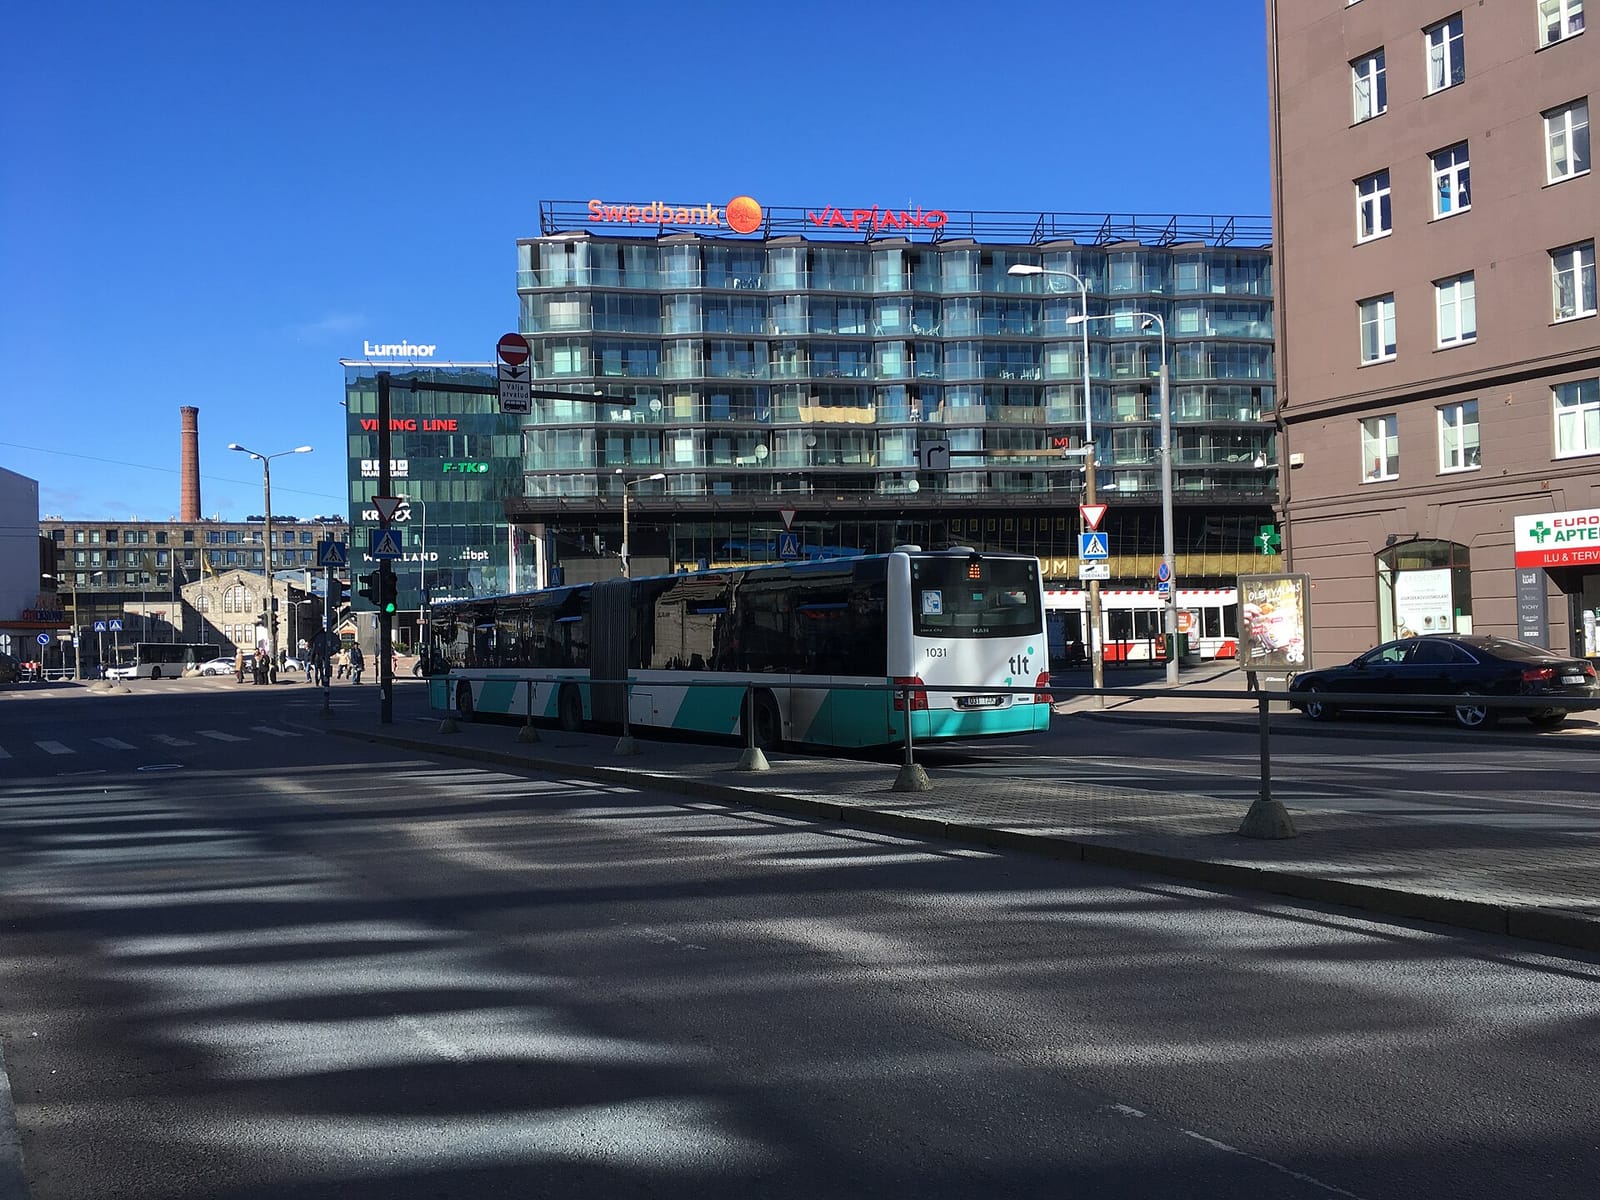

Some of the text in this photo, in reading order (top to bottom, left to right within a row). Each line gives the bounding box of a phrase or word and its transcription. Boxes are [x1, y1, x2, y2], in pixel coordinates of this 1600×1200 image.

[588, 199, 720, 225] Swedbank
[808, 204, 949, 232] VAPIANO
[363, 340, 436, 356] Luminor
[360, 419, 457, 431] VIING LINE
[1553, 515, 1600, 528] EURO
[1554, 527, 1600, 542] APTE
[363, 552, 439, 562] WLAND
[1543, 553, 1560, 563] ILU
[1562, 552, 1569, 562] &
[926, 648, 947, 658] 1031
[1008, 654, 1030, 675] tlt
